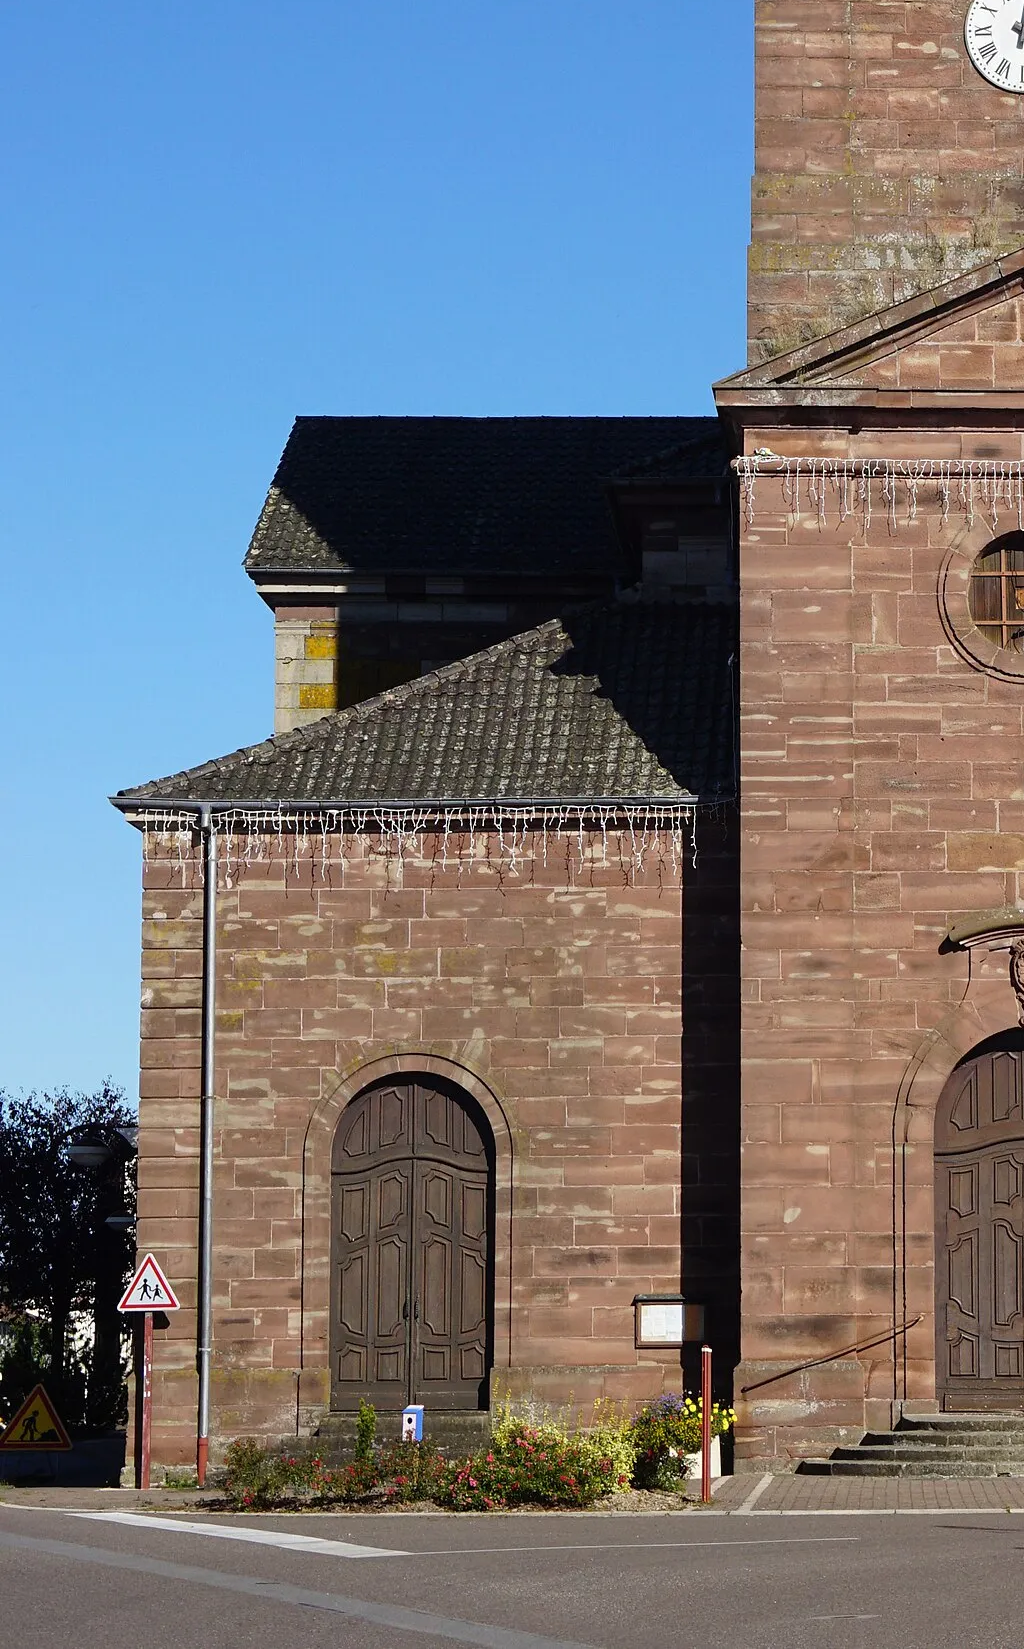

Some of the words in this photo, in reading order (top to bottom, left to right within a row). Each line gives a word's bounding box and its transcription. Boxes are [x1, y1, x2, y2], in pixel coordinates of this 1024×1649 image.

[980, 3, 998, 18] X
[974, 25, 992, 37] IX
[978, 41, 998, 65] VIII
[995, 58, 1011, 80] VII
